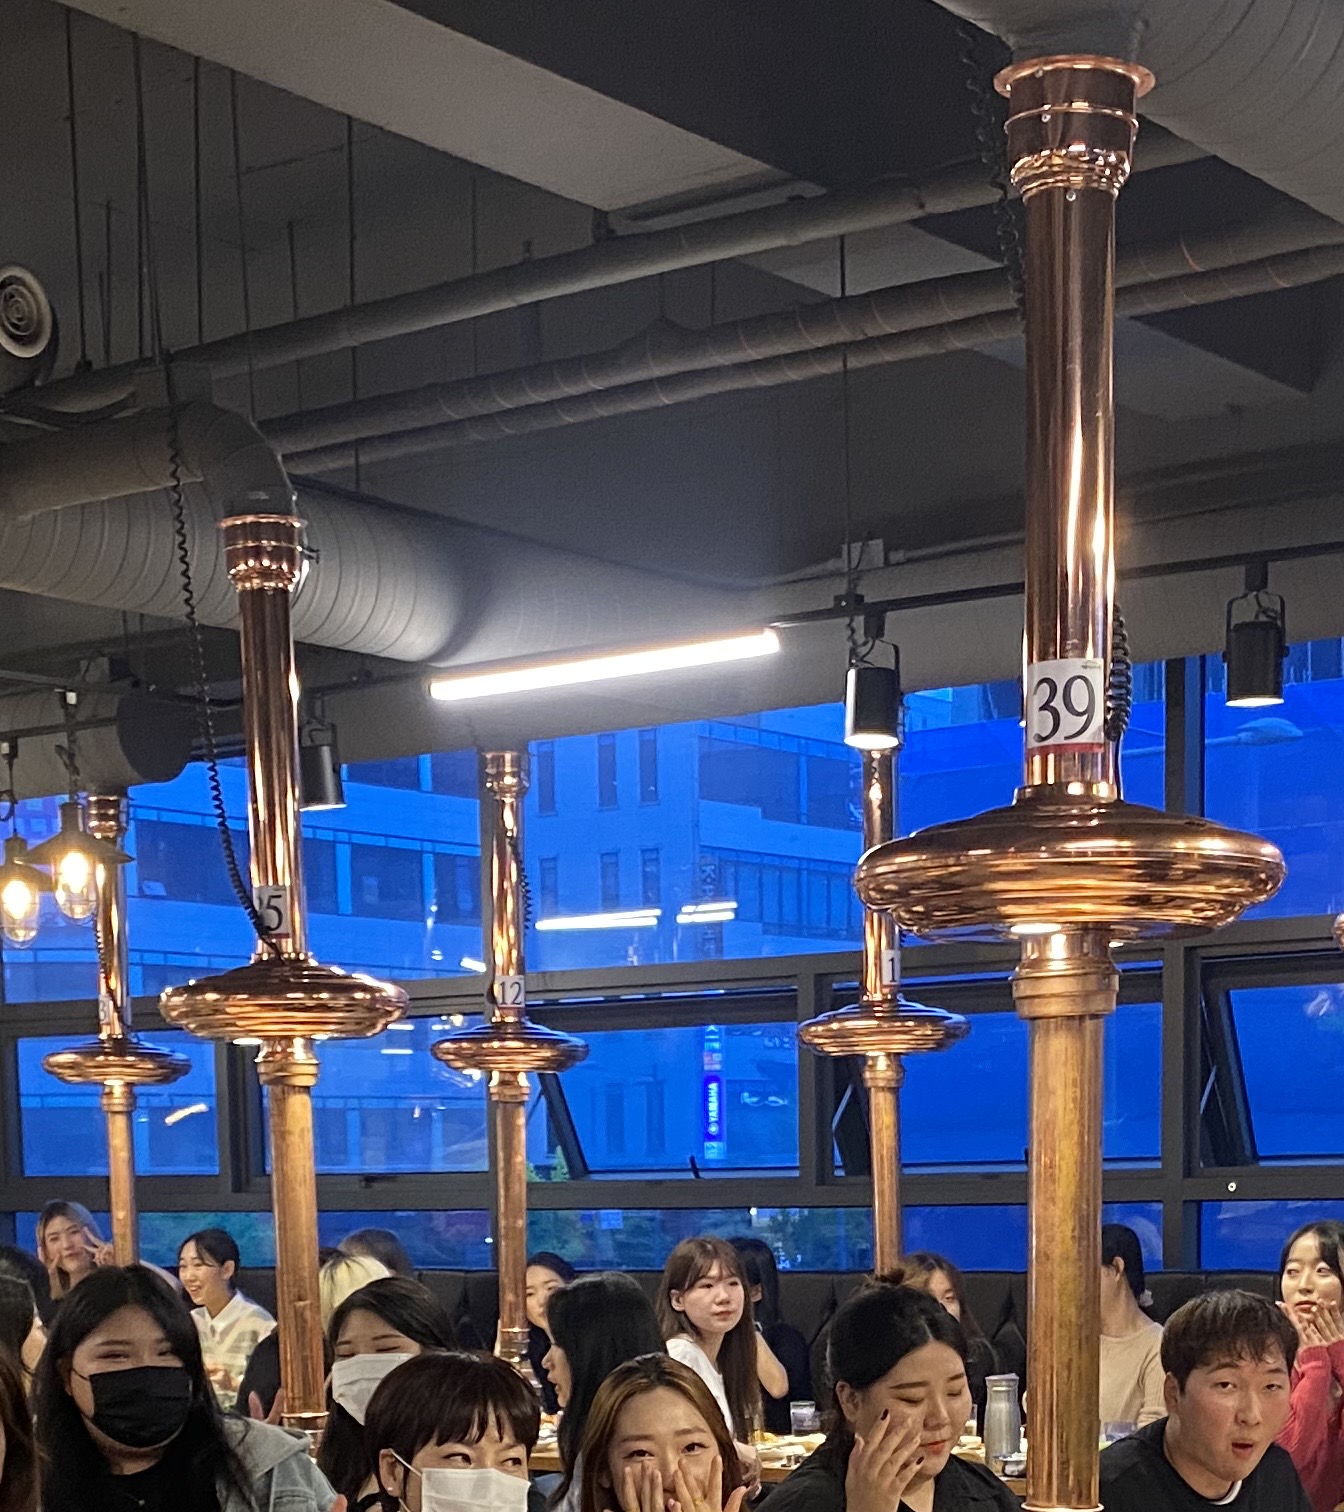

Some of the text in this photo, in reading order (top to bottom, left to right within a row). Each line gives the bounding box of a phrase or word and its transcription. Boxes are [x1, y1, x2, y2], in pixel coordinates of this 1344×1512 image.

[1033, 674, 1096, 743] 39
[499, 981, 522, 1005] 12
[707, 1082, 718, 1122] YAMAHA
